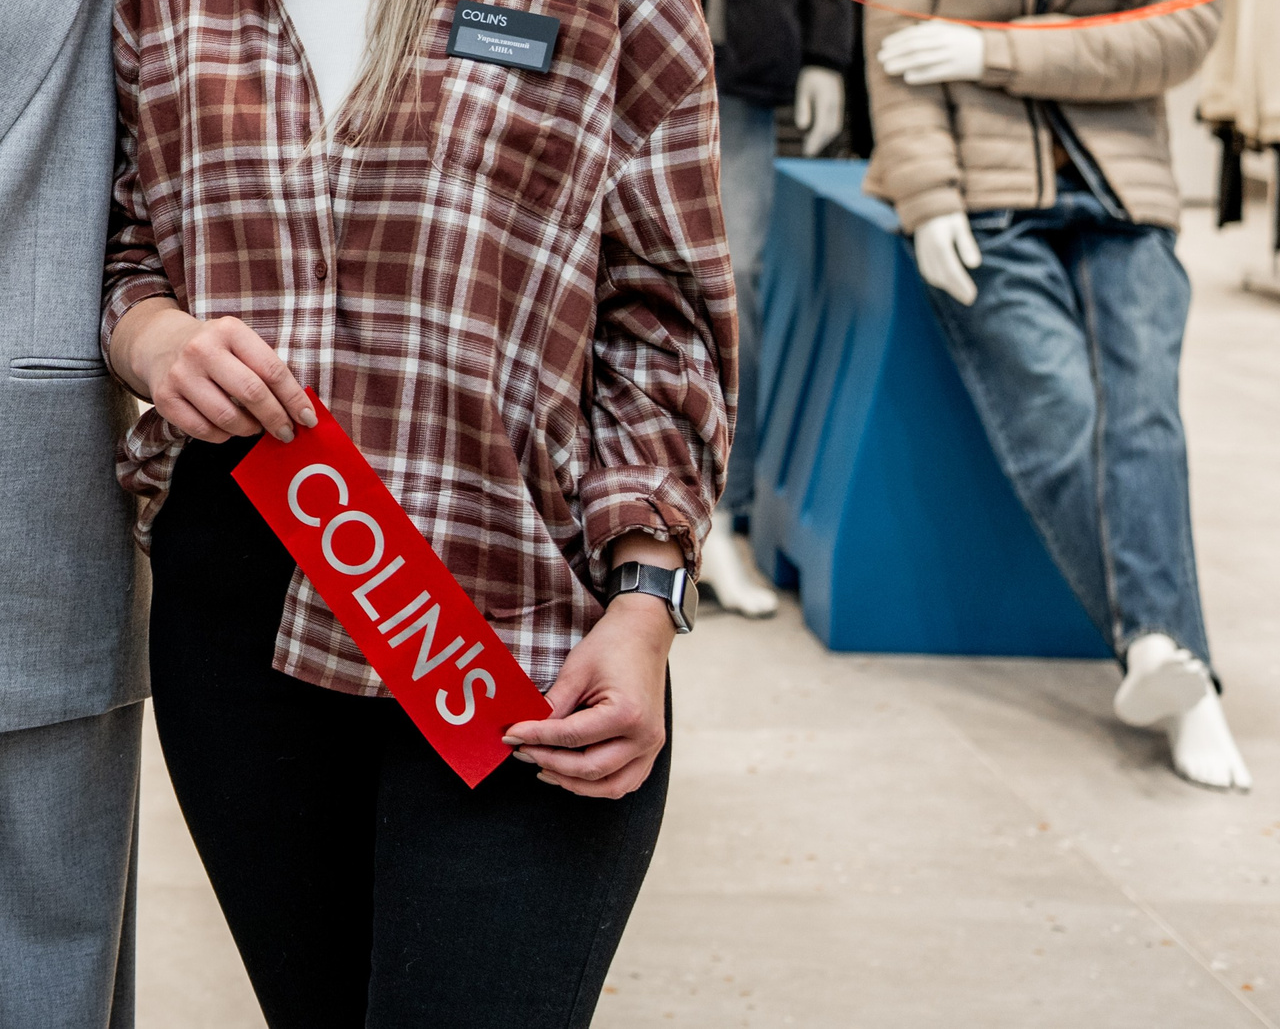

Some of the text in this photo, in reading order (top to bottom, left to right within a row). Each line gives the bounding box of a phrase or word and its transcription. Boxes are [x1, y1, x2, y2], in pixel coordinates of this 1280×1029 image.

[461, 9, 508, 27] COLIN'S
[476, 33, 530, 49] Управляющий
[488, 45, 513, 55] АННА
[287, 463, 496, 725] COLIN'S
